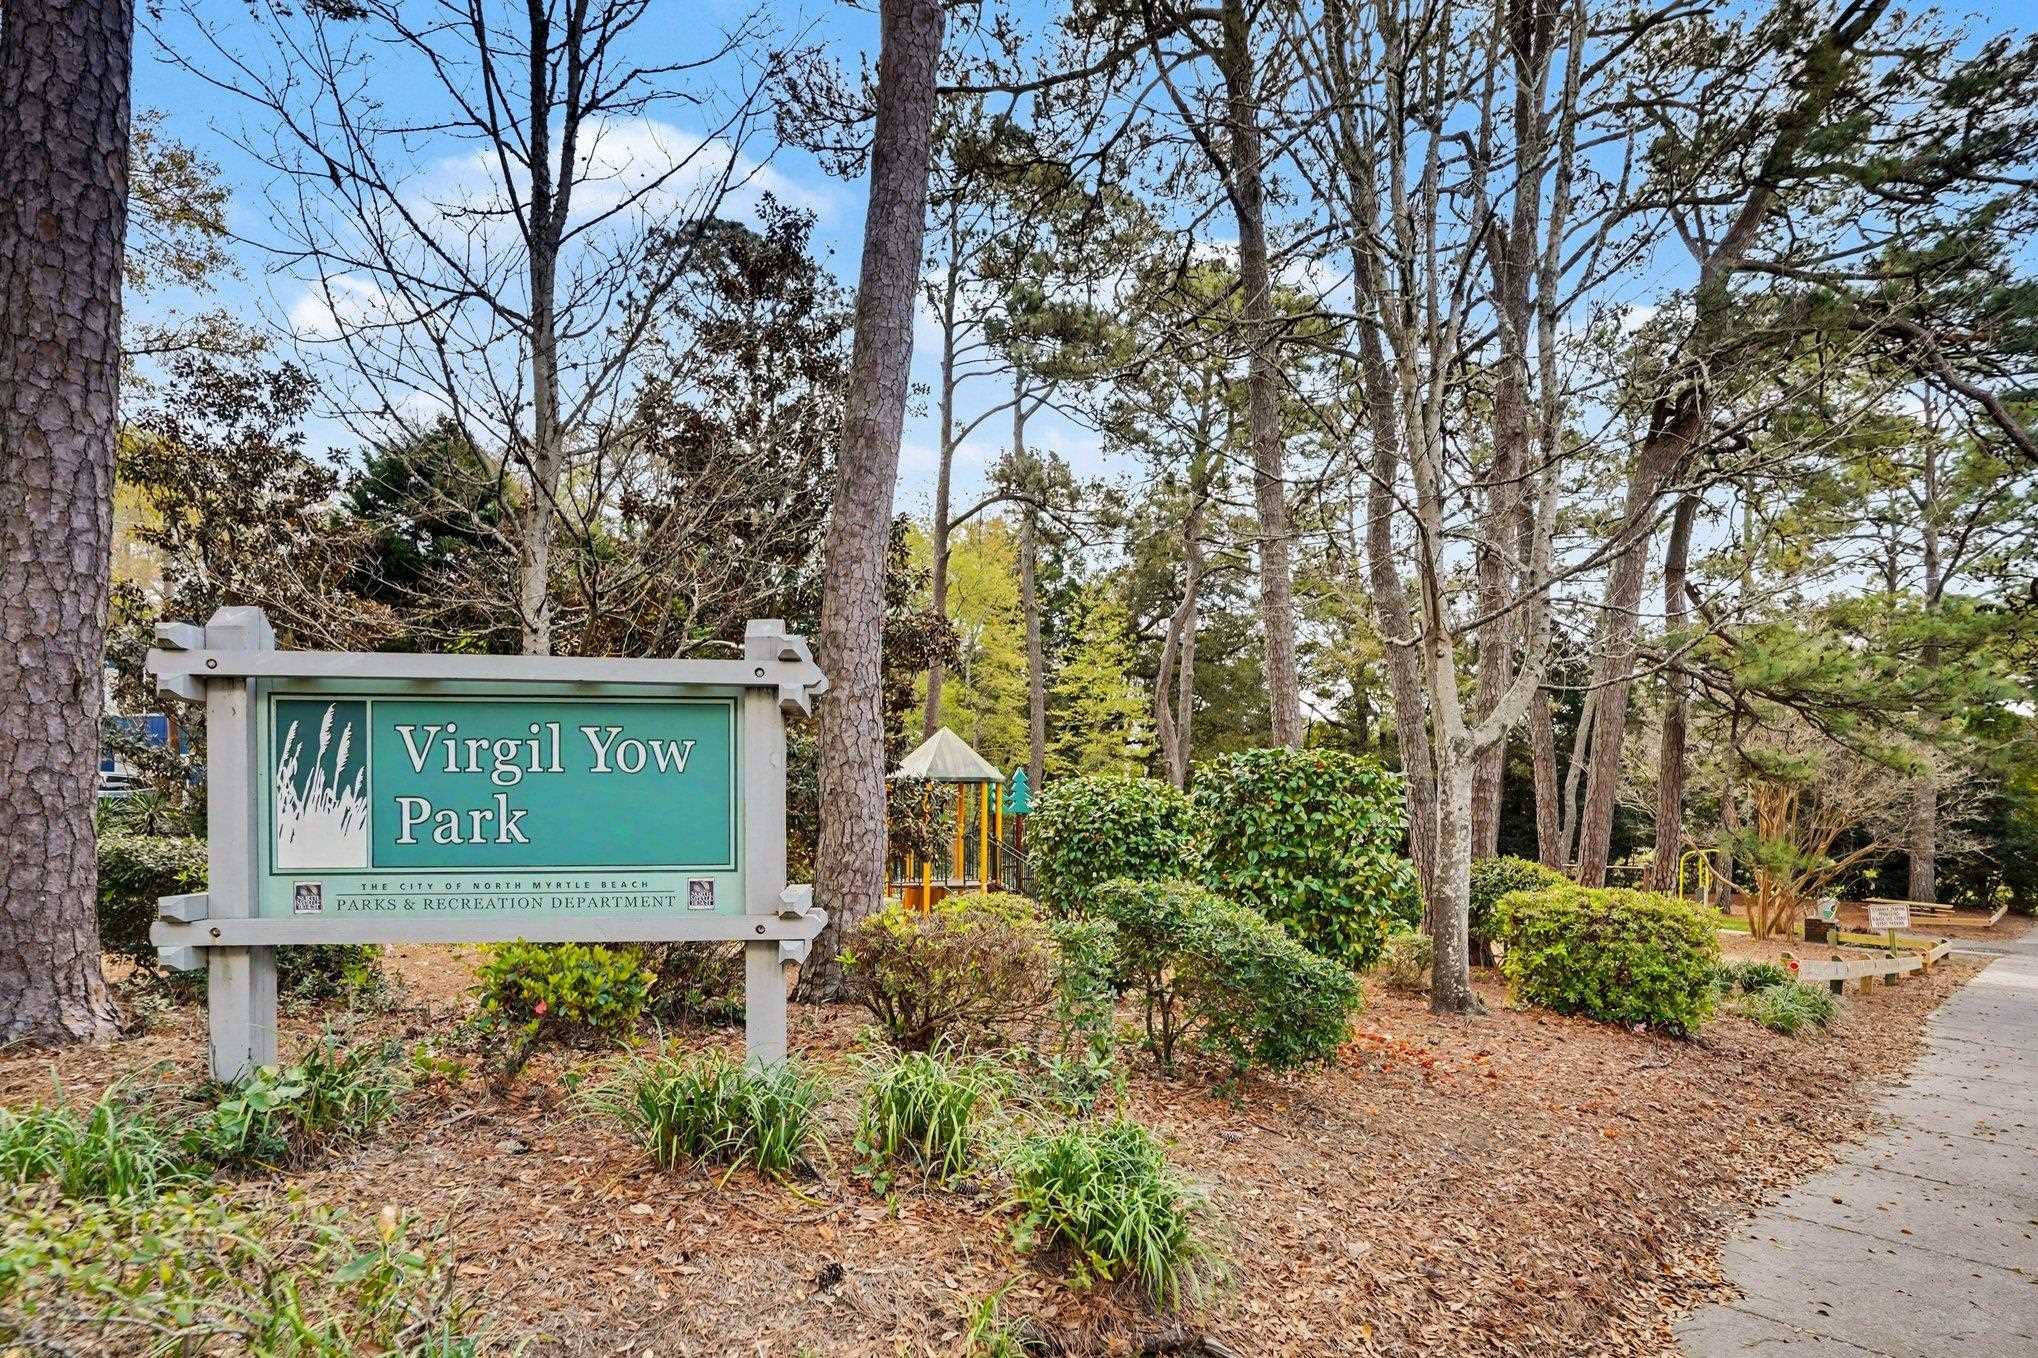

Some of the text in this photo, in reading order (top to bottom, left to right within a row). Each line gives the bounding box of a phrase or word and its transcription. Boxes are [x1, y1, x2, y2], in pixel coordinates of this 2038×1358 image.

[395, 722, 696, 786] Virgil Yow
[394, 792, 530, 845] Park
[360, 880, 649, 891] THE CITY OF NORTH MYRTLE BEACH
[336, 898, 397, 912] PARKS
[403, 898, 416, 911] &
[423, 897, 544, 911] RECREATION
[551, 895, 677, 909] DEPARTMENT
